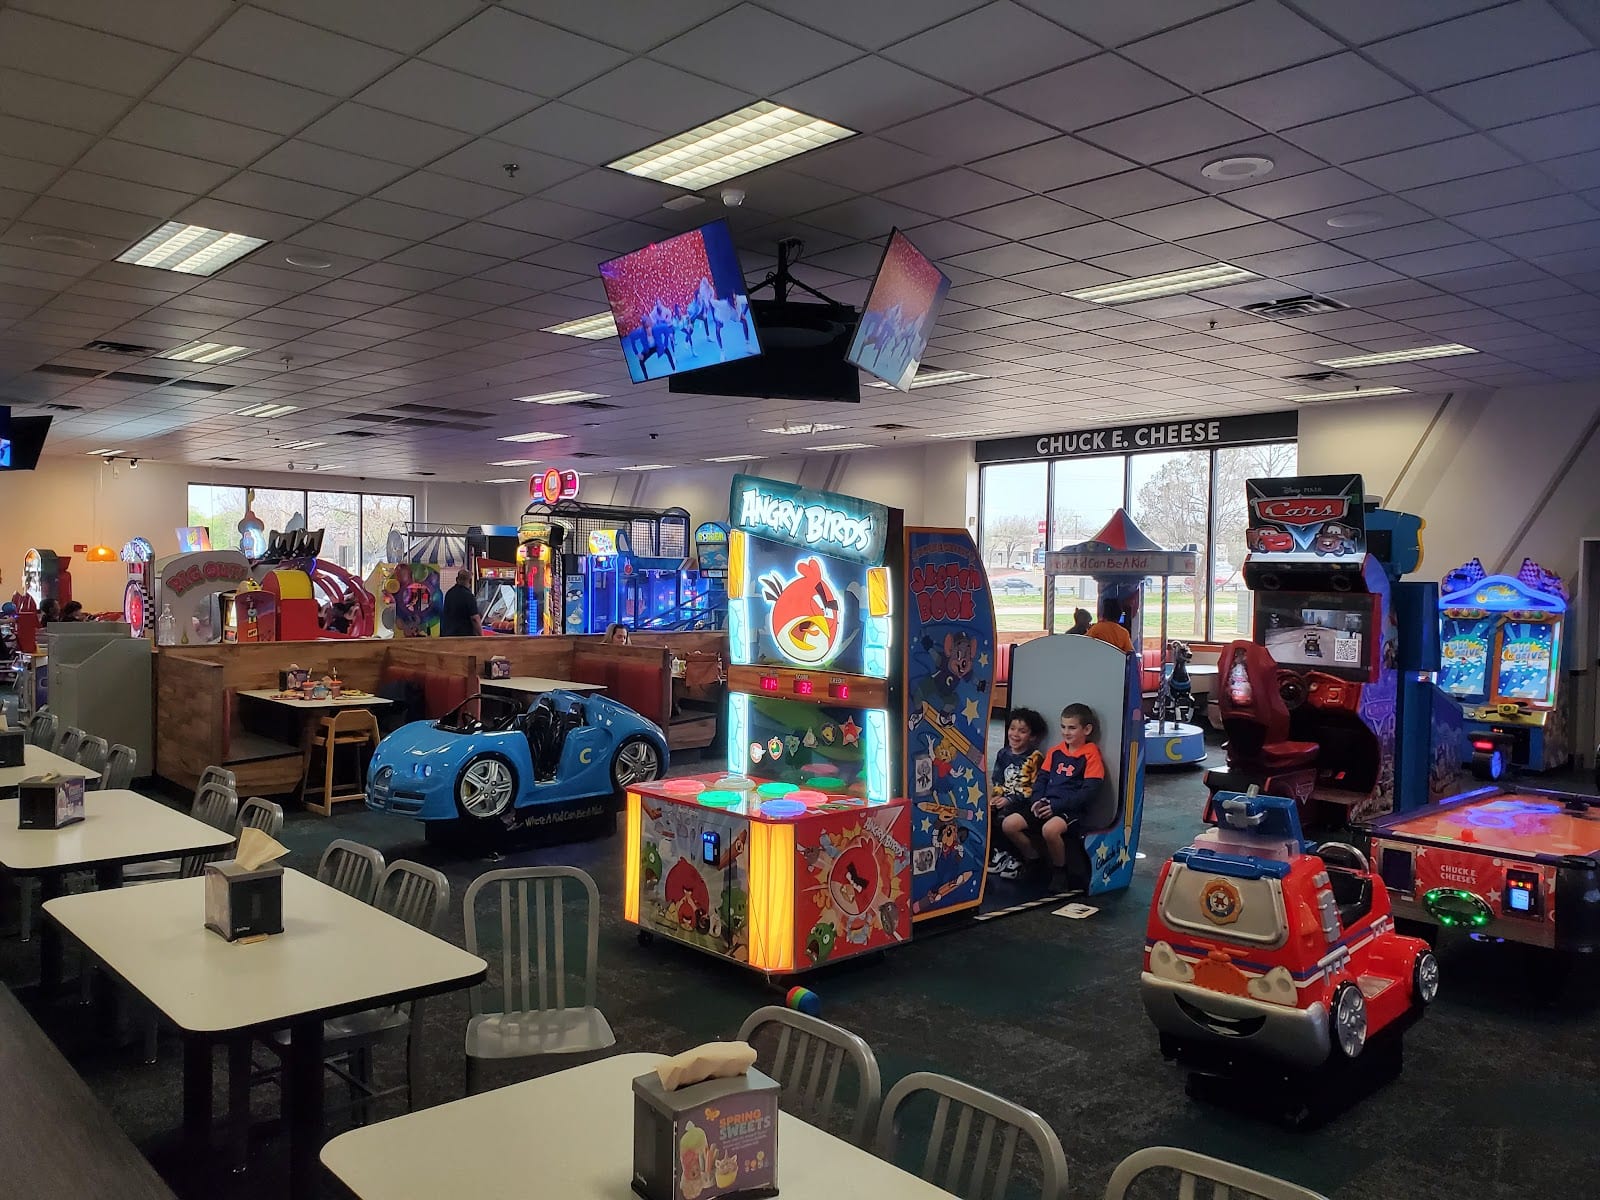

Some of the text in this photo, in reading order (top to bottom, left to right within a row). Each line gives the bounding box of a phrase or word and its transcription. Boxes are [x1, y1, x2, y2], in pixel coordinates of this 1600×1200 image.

[1036, 422, 1220, 454] CHUCK E. CHEESE
[739, 488, 873, 551] ANGRY BIRDS
[1265, 502, 1336, 517] Cars
[916, 590, 976, 624] BOOK
[1440, 864, 1468, 875] CHUCK
[720, 1109, 761, 1127] SPRING
[720, 1116, 771, 1140] SWEETS
